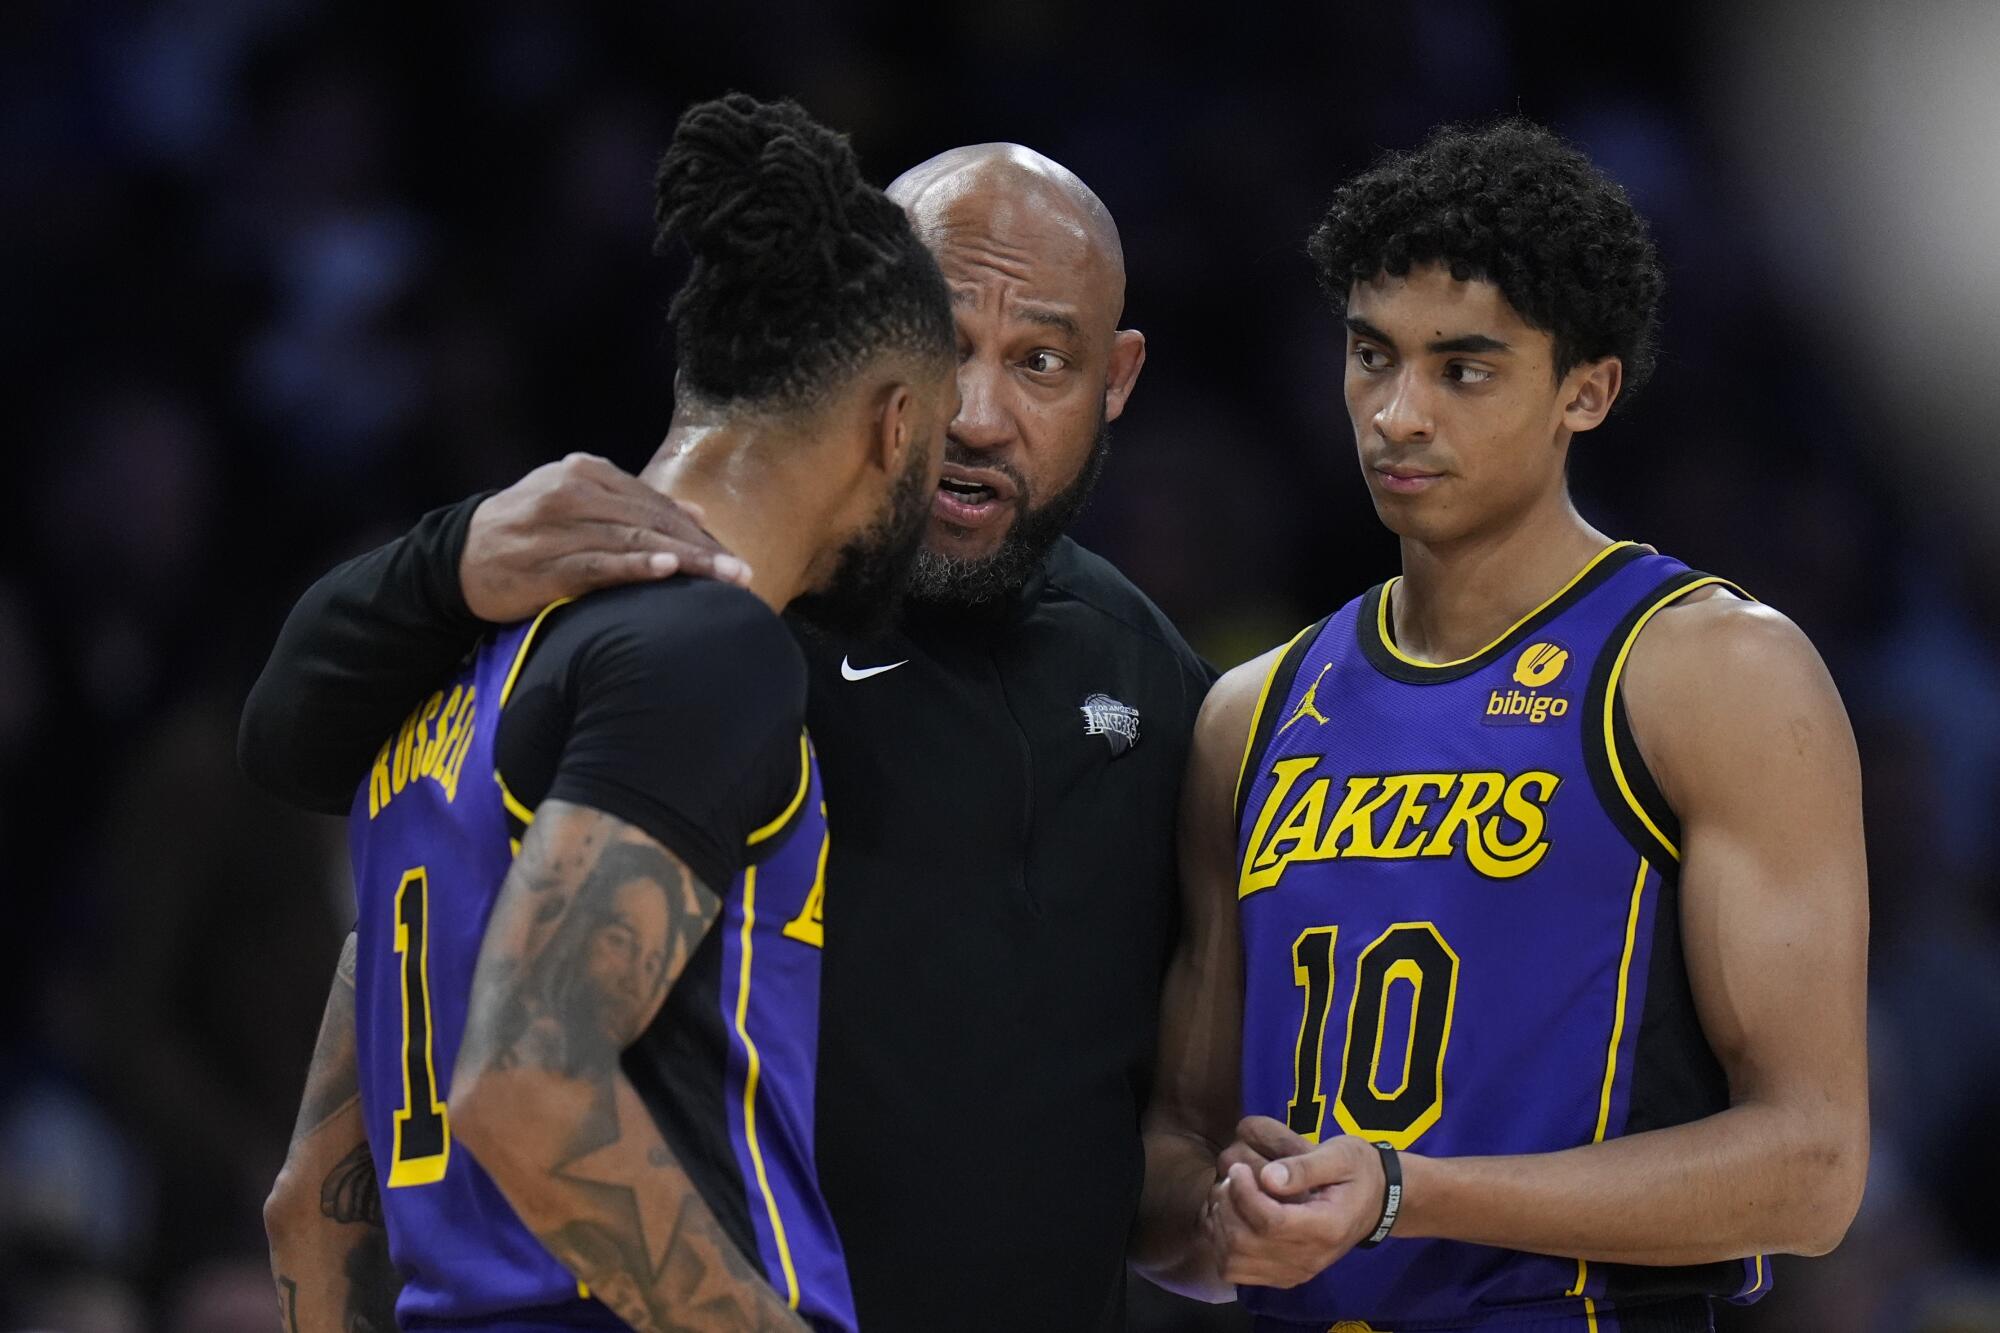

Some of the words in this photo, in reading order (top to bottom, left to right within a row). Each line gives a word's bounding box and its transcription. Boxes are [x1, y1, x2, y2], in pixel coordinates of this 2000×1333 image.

[1080, 705, 1140, 739] LAKERS
[1486, 690, 1568, 723] bibigo
[1238, 755, 1562, 901] LAKERS
[387, 866, 450, 1188] 1
[1287, 921, 1461, 1151] 10
